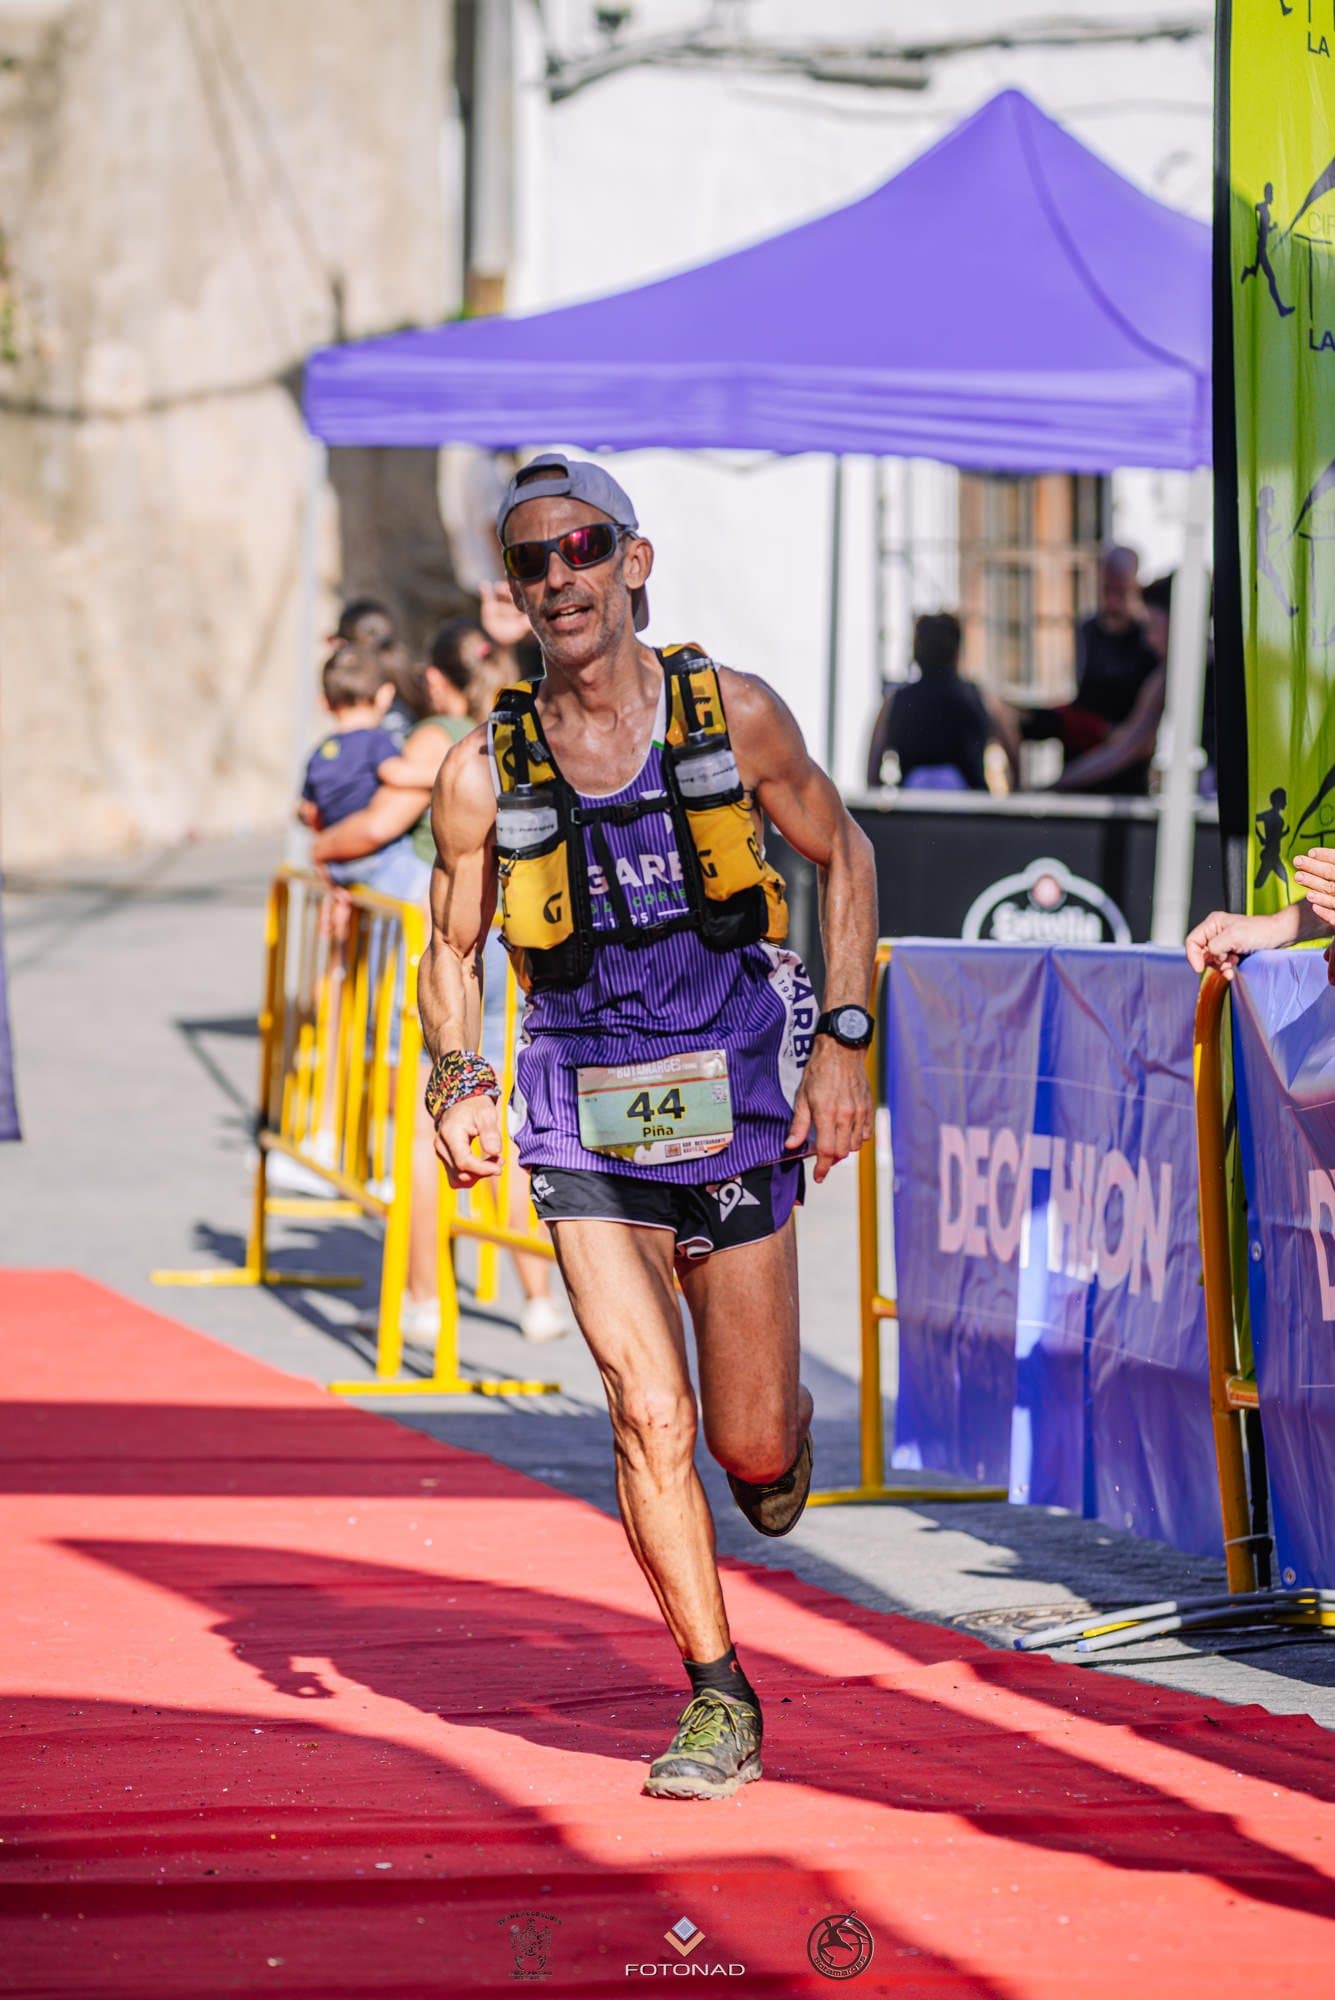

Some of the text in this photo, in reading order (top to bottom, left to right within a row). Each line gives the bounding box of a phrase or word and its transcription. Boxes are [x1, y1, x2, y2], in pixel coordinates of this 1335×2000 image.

[1307, 31, 1331, 58] LA
[626, 1088, 686, 1122] 44
[643, 1125, 674, 1138] Piña
